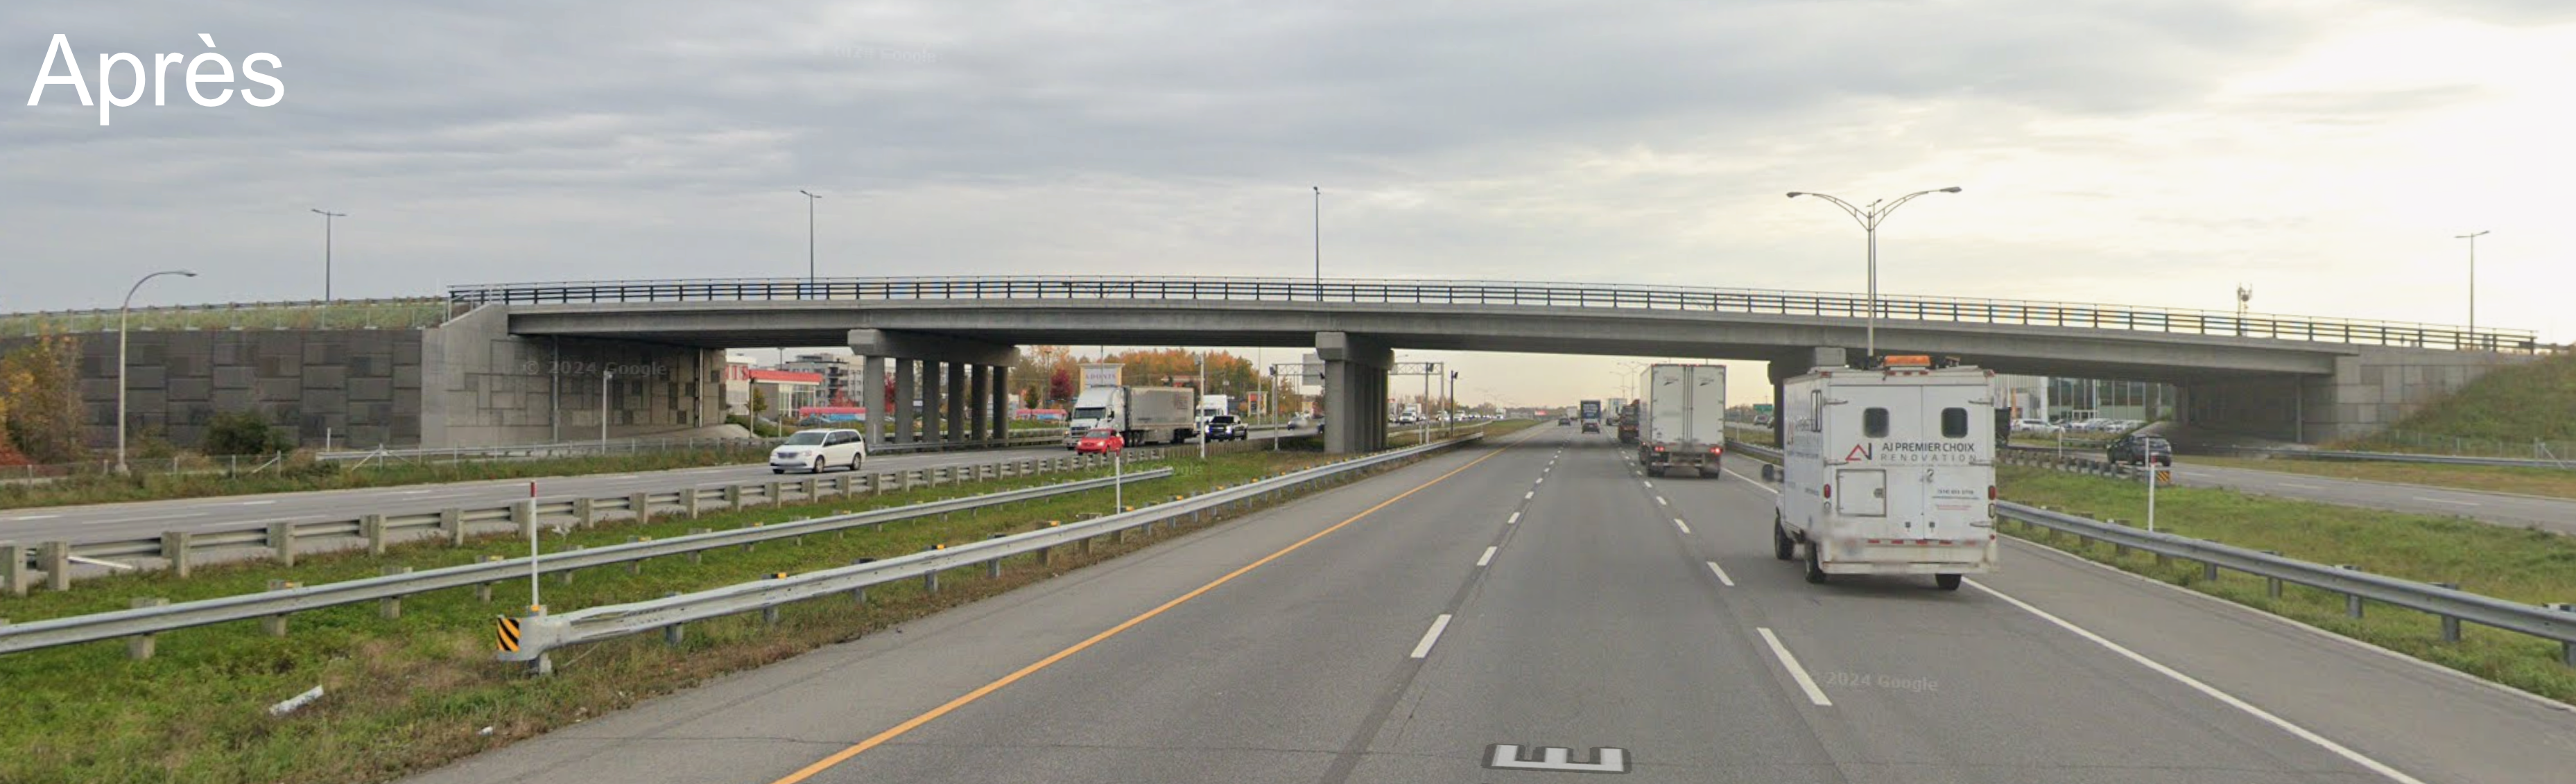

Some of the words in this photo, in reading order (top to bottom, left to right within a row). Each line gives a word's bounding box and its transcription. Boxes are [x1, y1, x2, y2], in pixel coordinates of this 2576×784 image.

[1882, 442, 1894, 452] AJ
[1895, 442, 1940, 452] PREMIER
[1943, 443, 1975, 452] CHOIX
[1881, 454, 1976, 462] RENOVATION
